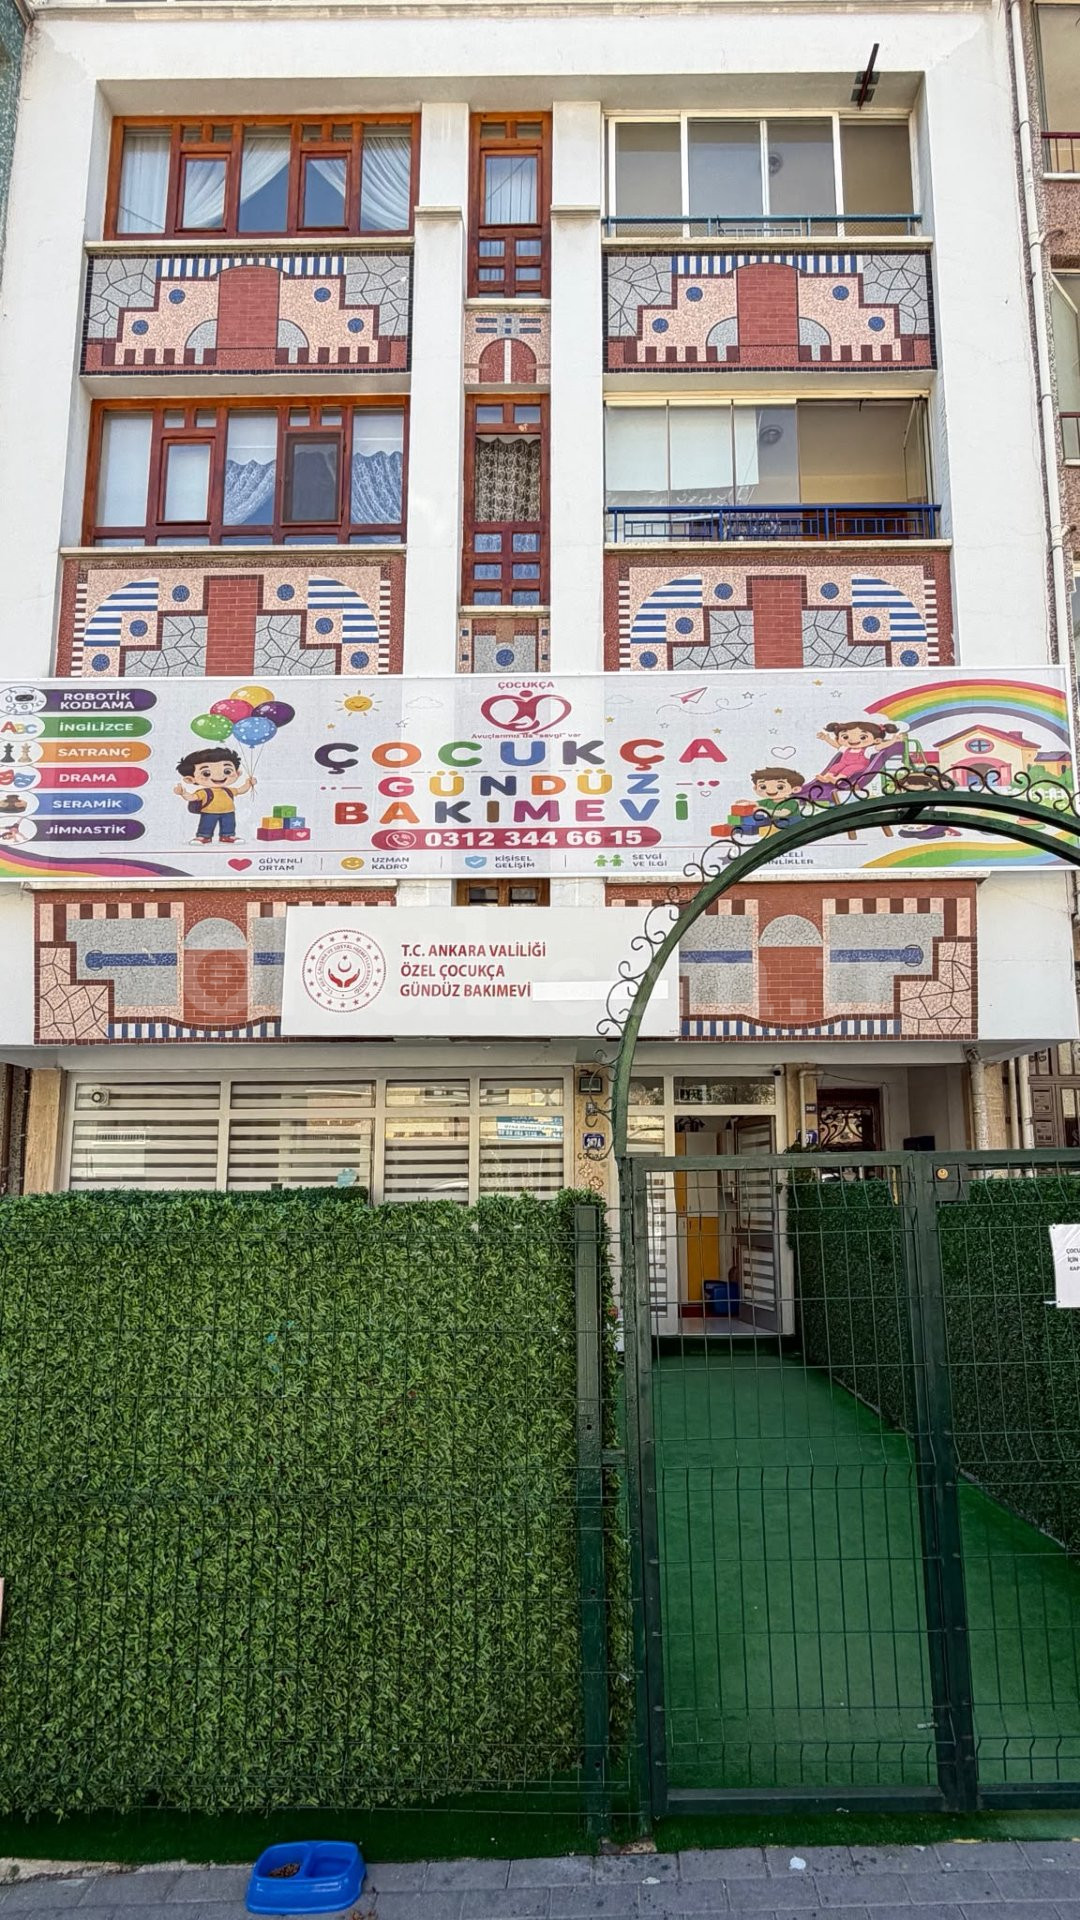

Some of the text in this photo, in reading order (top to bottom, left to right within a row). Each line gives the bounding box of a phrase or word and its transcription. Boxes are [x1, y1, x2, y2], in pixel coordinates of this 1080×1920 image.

[498, 681, 555, 690] ÇOCUKÇA
[63, 690, 131, 701] ROBOTİK
[60, 701, 135, 710] KODLAMA
[60, 722, 134, 732] İNGİLİZCE
[58, 748, 131, 758] SATRANÇ
[315, 739, 728, 774] ÇOCUKÇA
[59, 773, 117, 783] DRAMA
[378, 769, 660, 797] GÜNDÜZ
[52, 798, 122, 809] SERAMİK
[335, 794, 689, 825] BAKIMEVİ
[45, 824, 127, 835] JİMNASTİK
[425, 830, 643, 847] 0312 344 66 15
[495, 854, 533, 862] KİŞİSEL
[648, 859, 668, 867] İLGİ
[495, 861, 535, 869] GELİŞİM
[401, 941, 546, 957] T.C. ANKARA VALİLİĞİ
[400, 961, 505, 981] ÖZEL ÇOCUKÇA
[400, 981, 531, 997] GÜNDÜZ BAKIMEVİ
